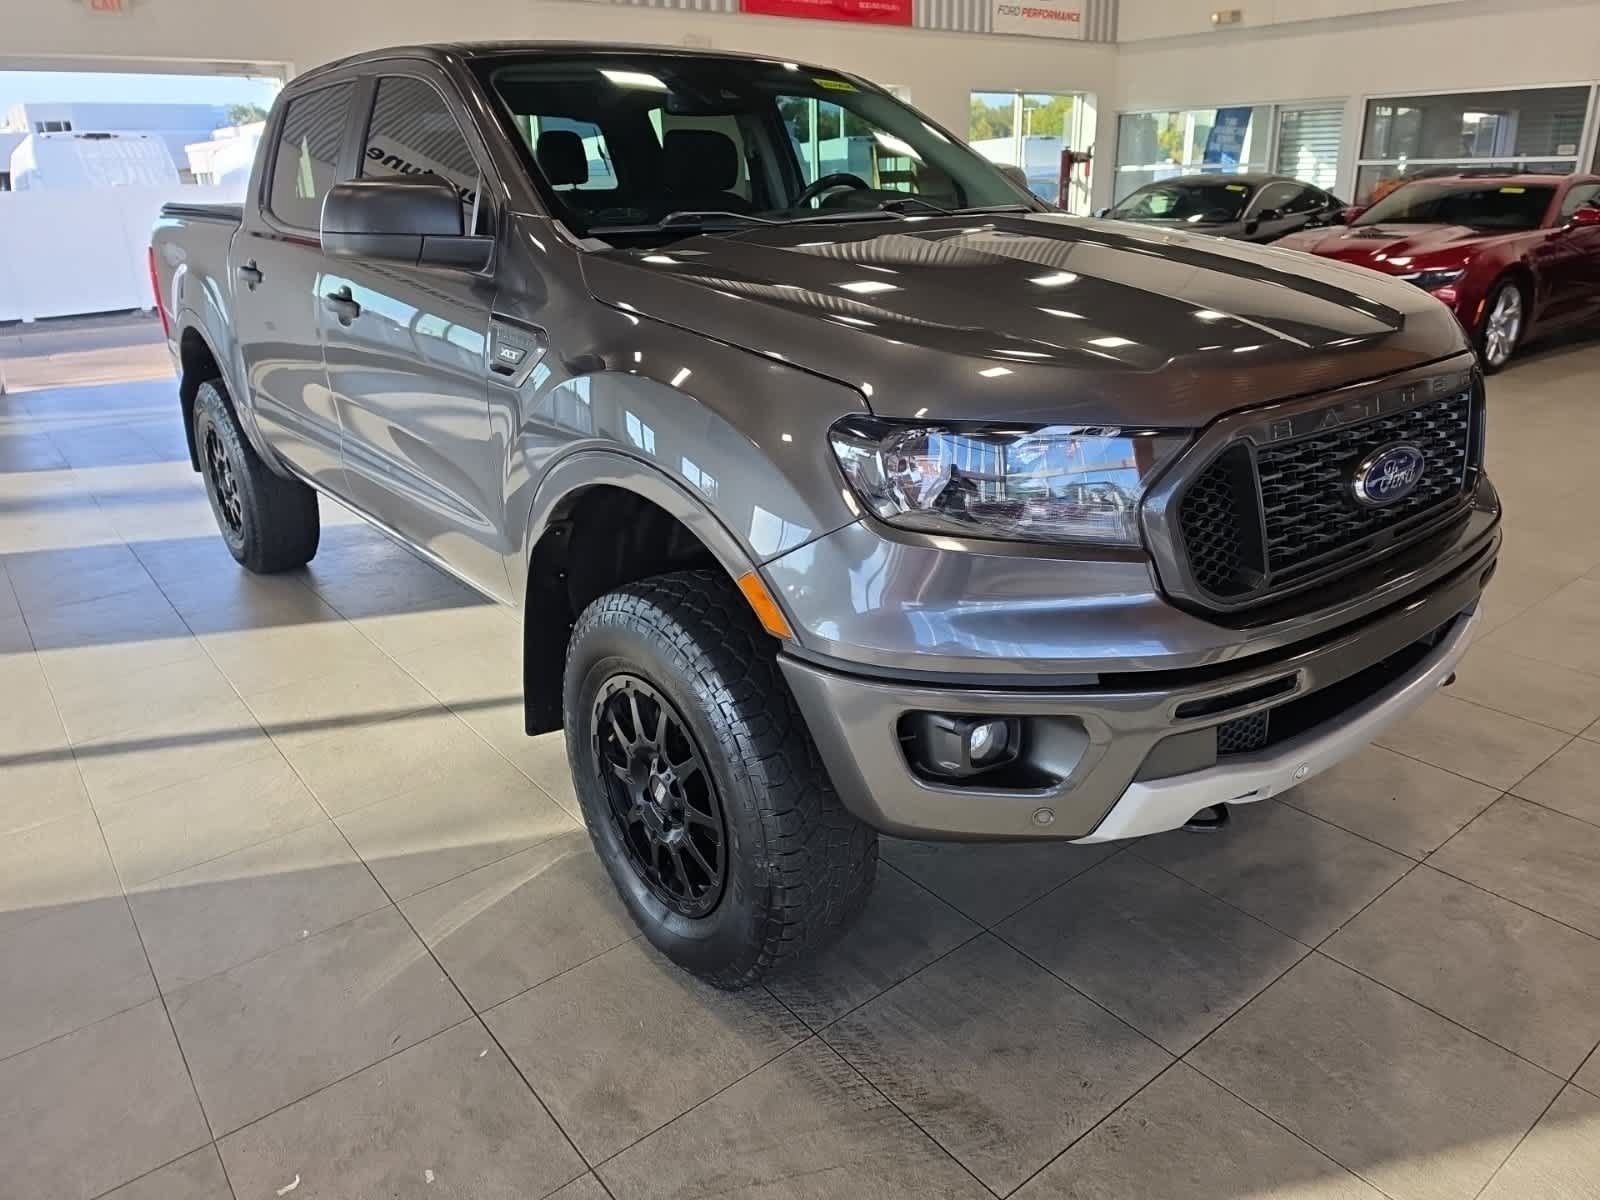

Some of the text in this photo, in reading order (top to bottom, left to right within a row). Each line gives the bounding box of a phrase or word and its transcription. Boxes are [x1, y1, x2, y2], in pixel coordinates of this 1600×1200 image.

[997, 5, 1081, 22] FORD PERFORMANCE
[501, 347, 520, 360] XLT
[1368, 459, 1416, 494] Ford
